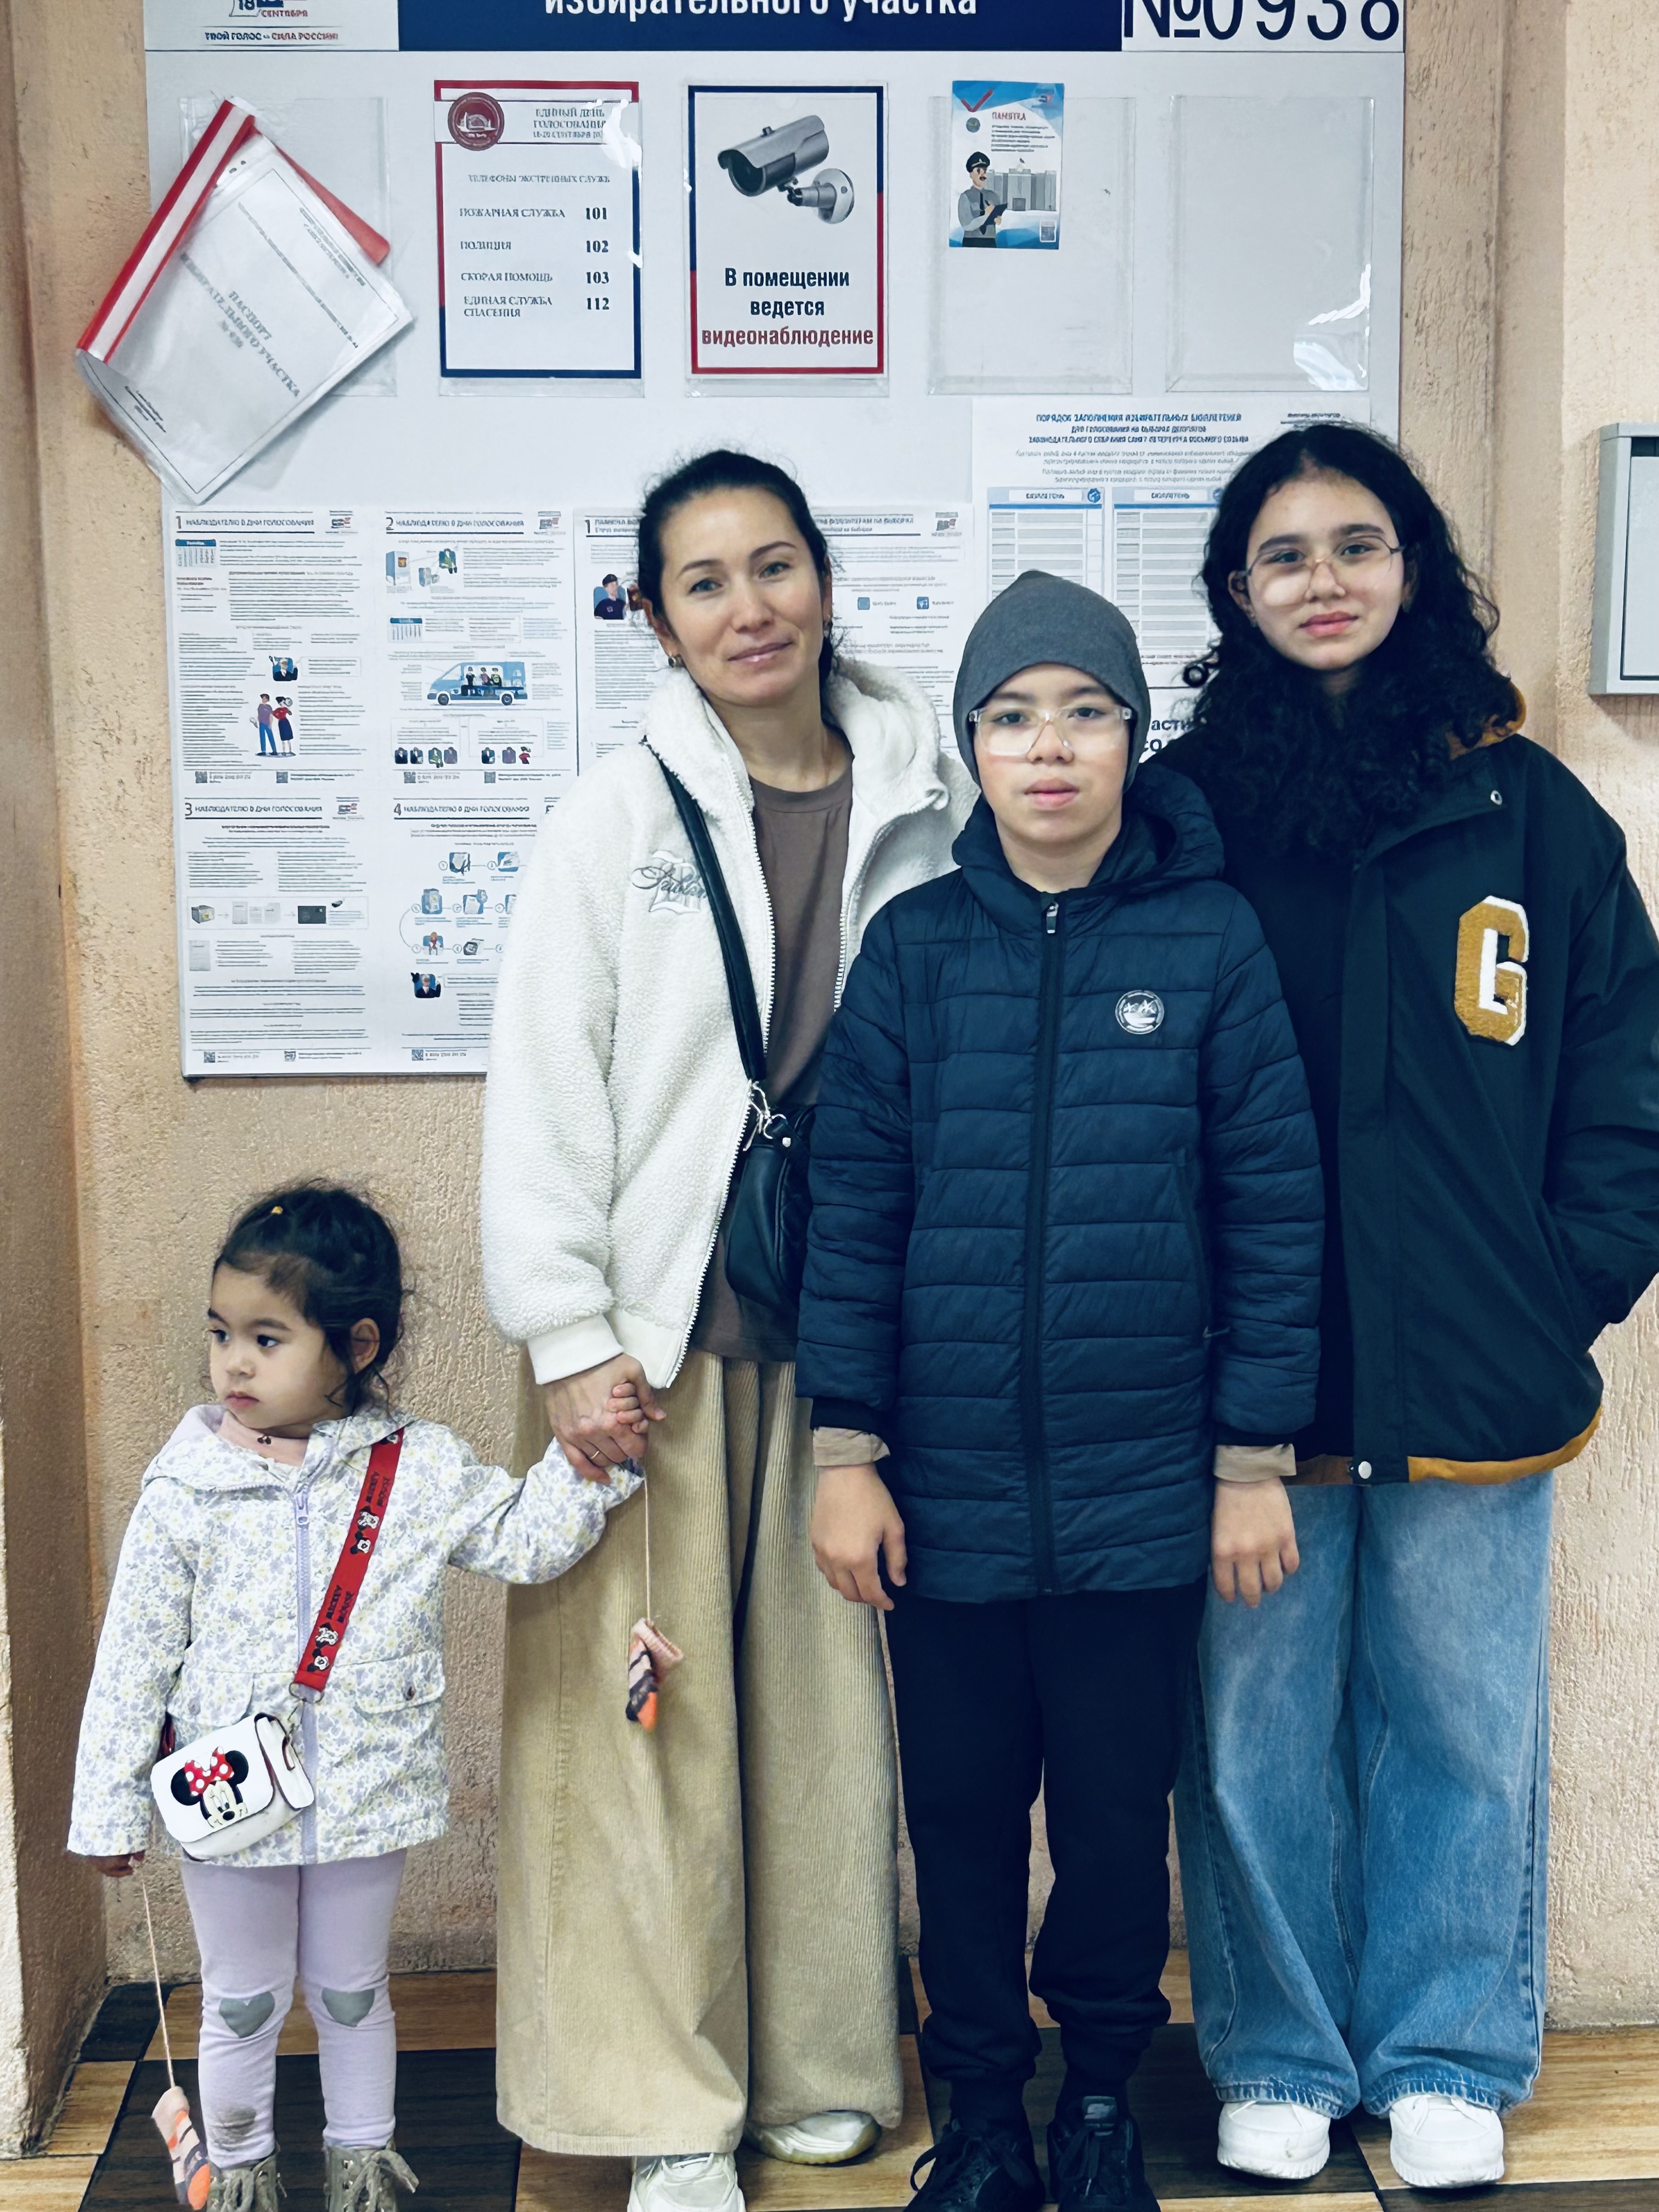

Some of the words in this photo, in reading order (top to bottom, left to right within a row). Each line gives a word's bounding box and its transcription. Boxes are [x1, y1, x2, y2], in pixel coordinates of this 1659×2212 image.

[468, 174, 517, 183] ТЕЛЕФОНЫ
[459, 208, 519, 217] ПОЖАРНАЯ
[521, 208, 566, 218] СЛУЖБА
[585, 207, 607, 221] 101
[460, 241, 512, 250] ПОЛИЦИЯ
[586, 240, 609, 253] 102
[461, 272, 503, 281] СКОРАЯ
[504, 272, 554, 282] ПОМОЩЬ
[586, 271, 610, 284] 103
[725, 267, 737, 286] В
[742, 268, 850, 290] помещении
[464, 296, 507, 305] ЕДИНАЯ
[509, 296, 553, 306] СЛУЖБА
[586, 297, 610, 311] 112
[750, 300, 825, 319] ведется
[464, 308, 521, 317] СПАСЕНИЯ
[702, 326, 874, 347] видеонаблюдение
[176, 516, 182, 529] 1
[386, 517, 394, 531] 2
[585, 520, 590, 534] 1
[184, 802, 193, 816] 3
[393, 803, 402, 816] 4
